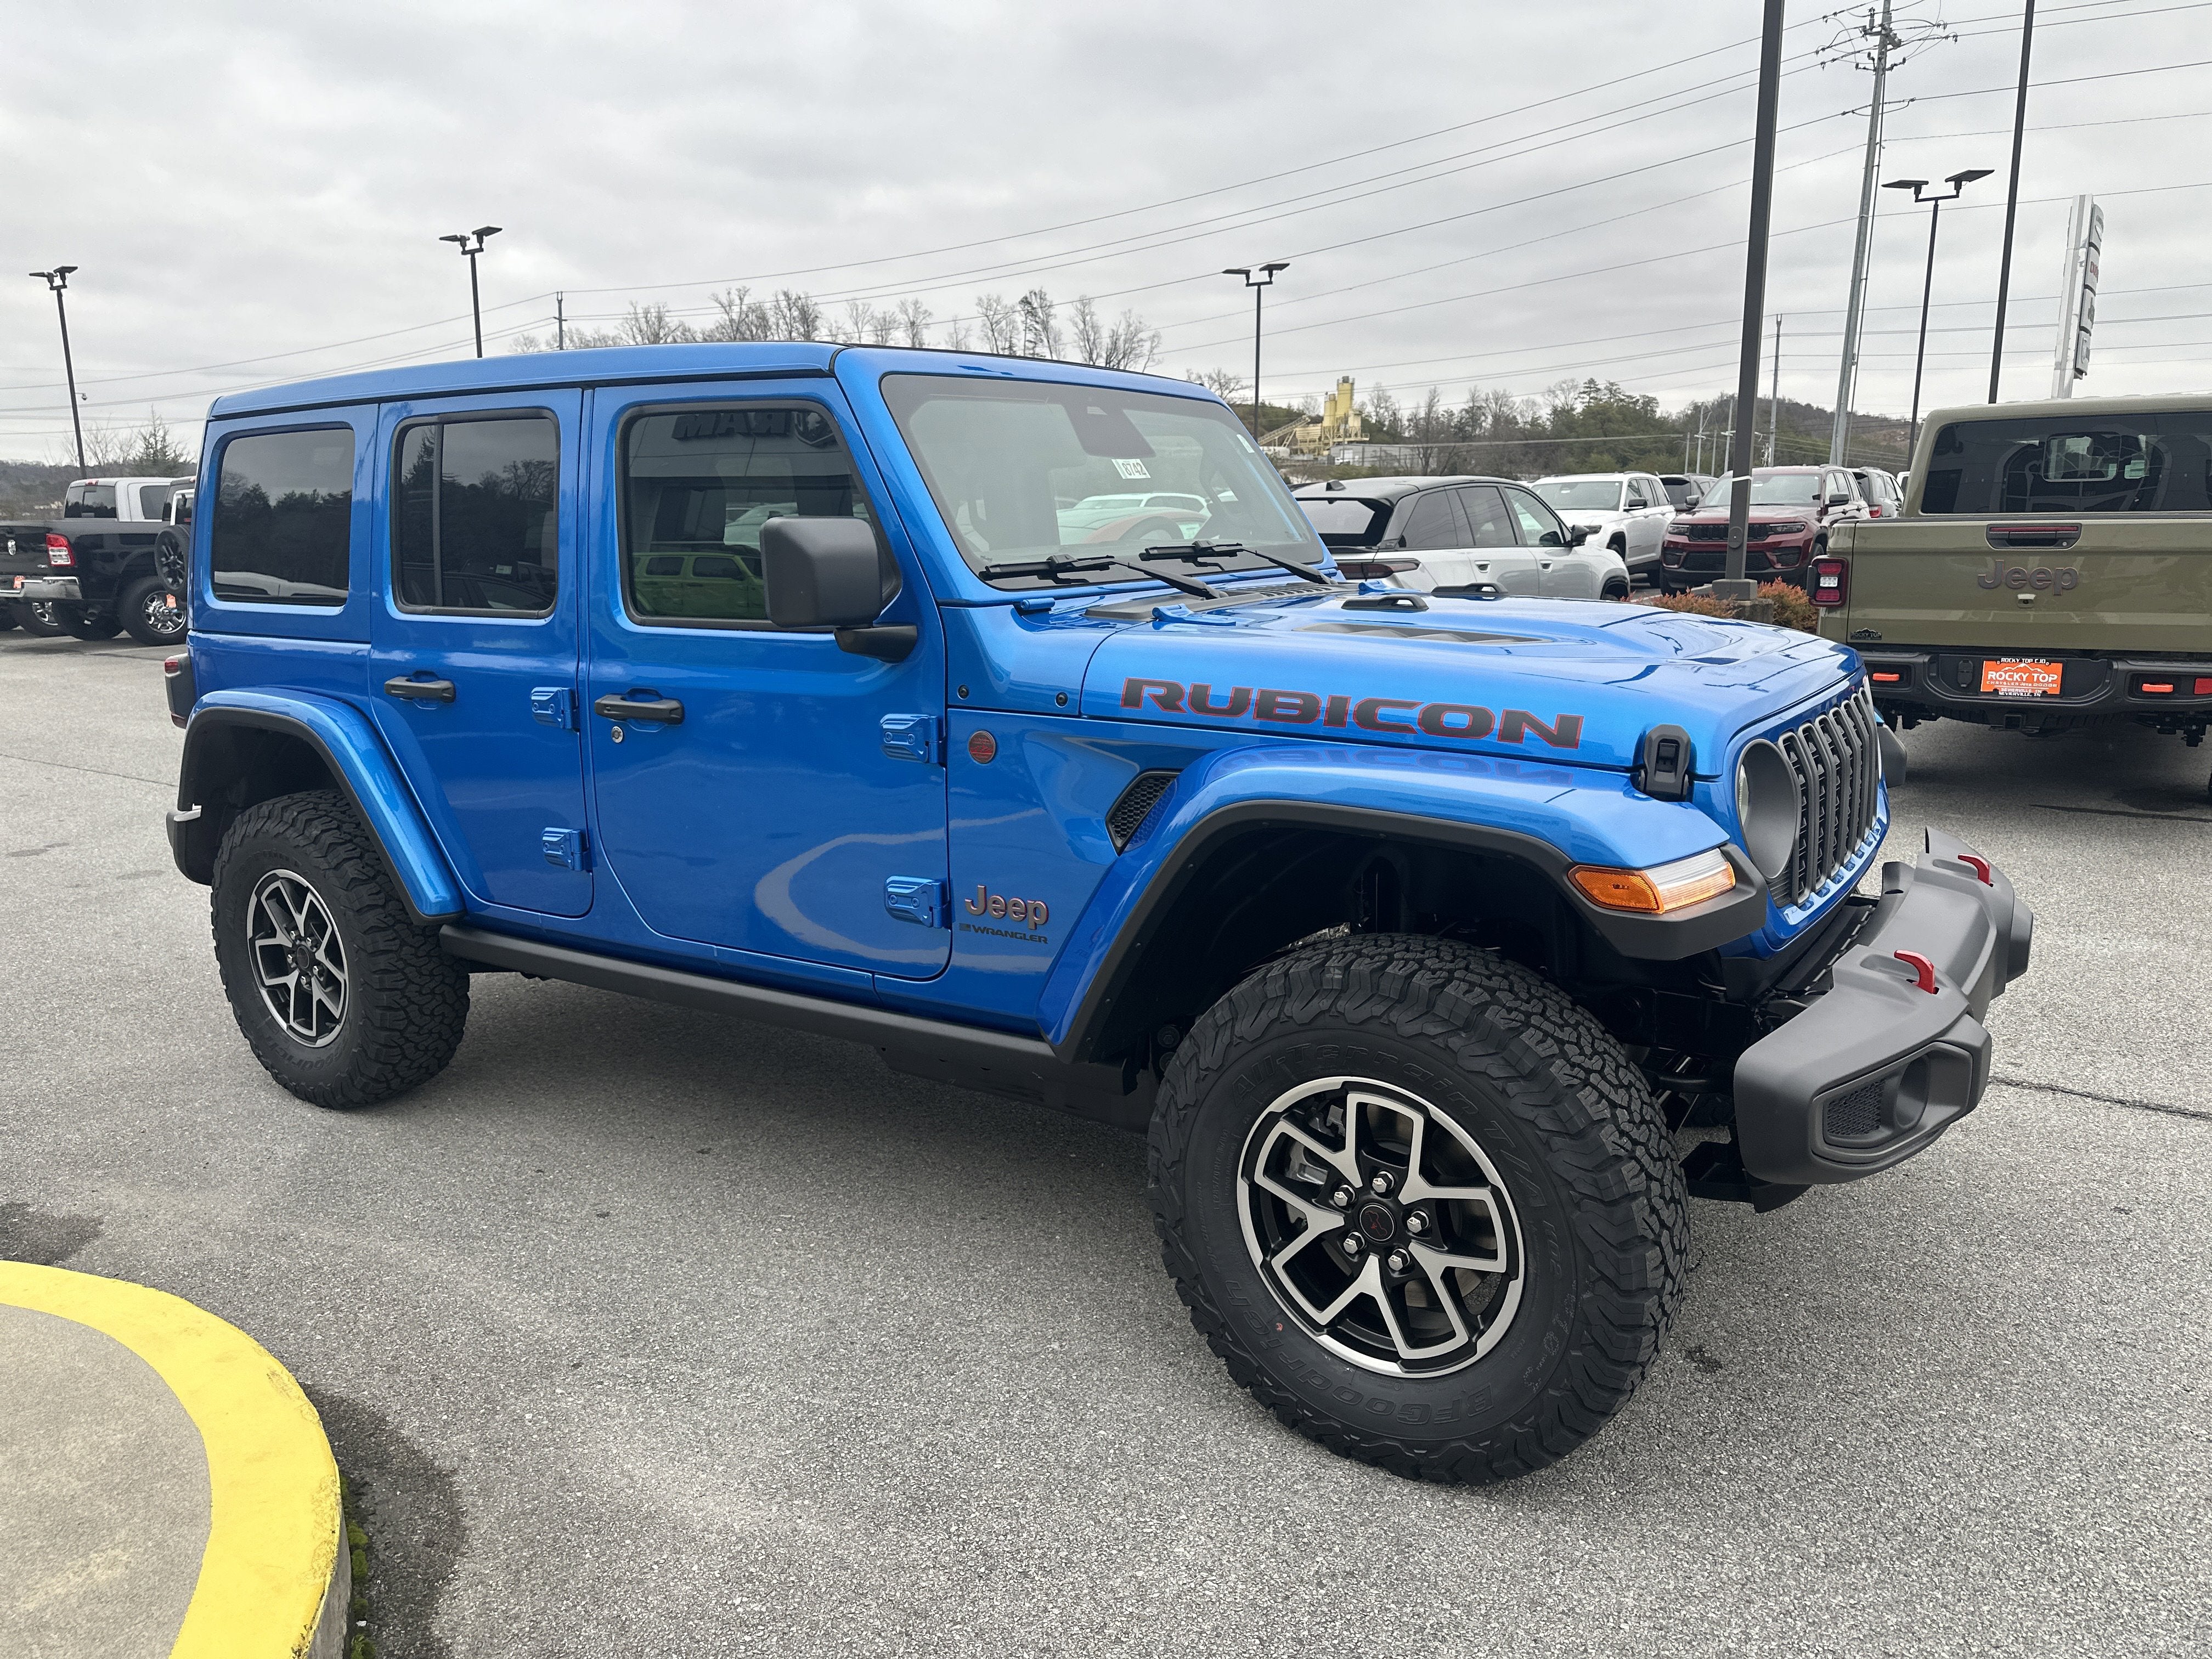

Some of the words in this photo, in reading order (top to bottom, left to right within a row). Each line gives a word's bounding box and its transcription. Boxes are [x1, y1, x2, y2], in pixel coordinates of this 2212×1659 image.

[1122, 462, 1147, 476] 8742
[1978, 560, 2079, 596] Jeep
[1988, 671, 2029, 681] ROCKY
[2032, 673, 2058, 682] TOP
[1120, 677, 1585, 749] RUBICON
[964, 884, 1049, 930] Jeep
[972, 924, 1048, 944] WRANGLER
[1225, 1280, 1494, 1425] BFGoodrich
